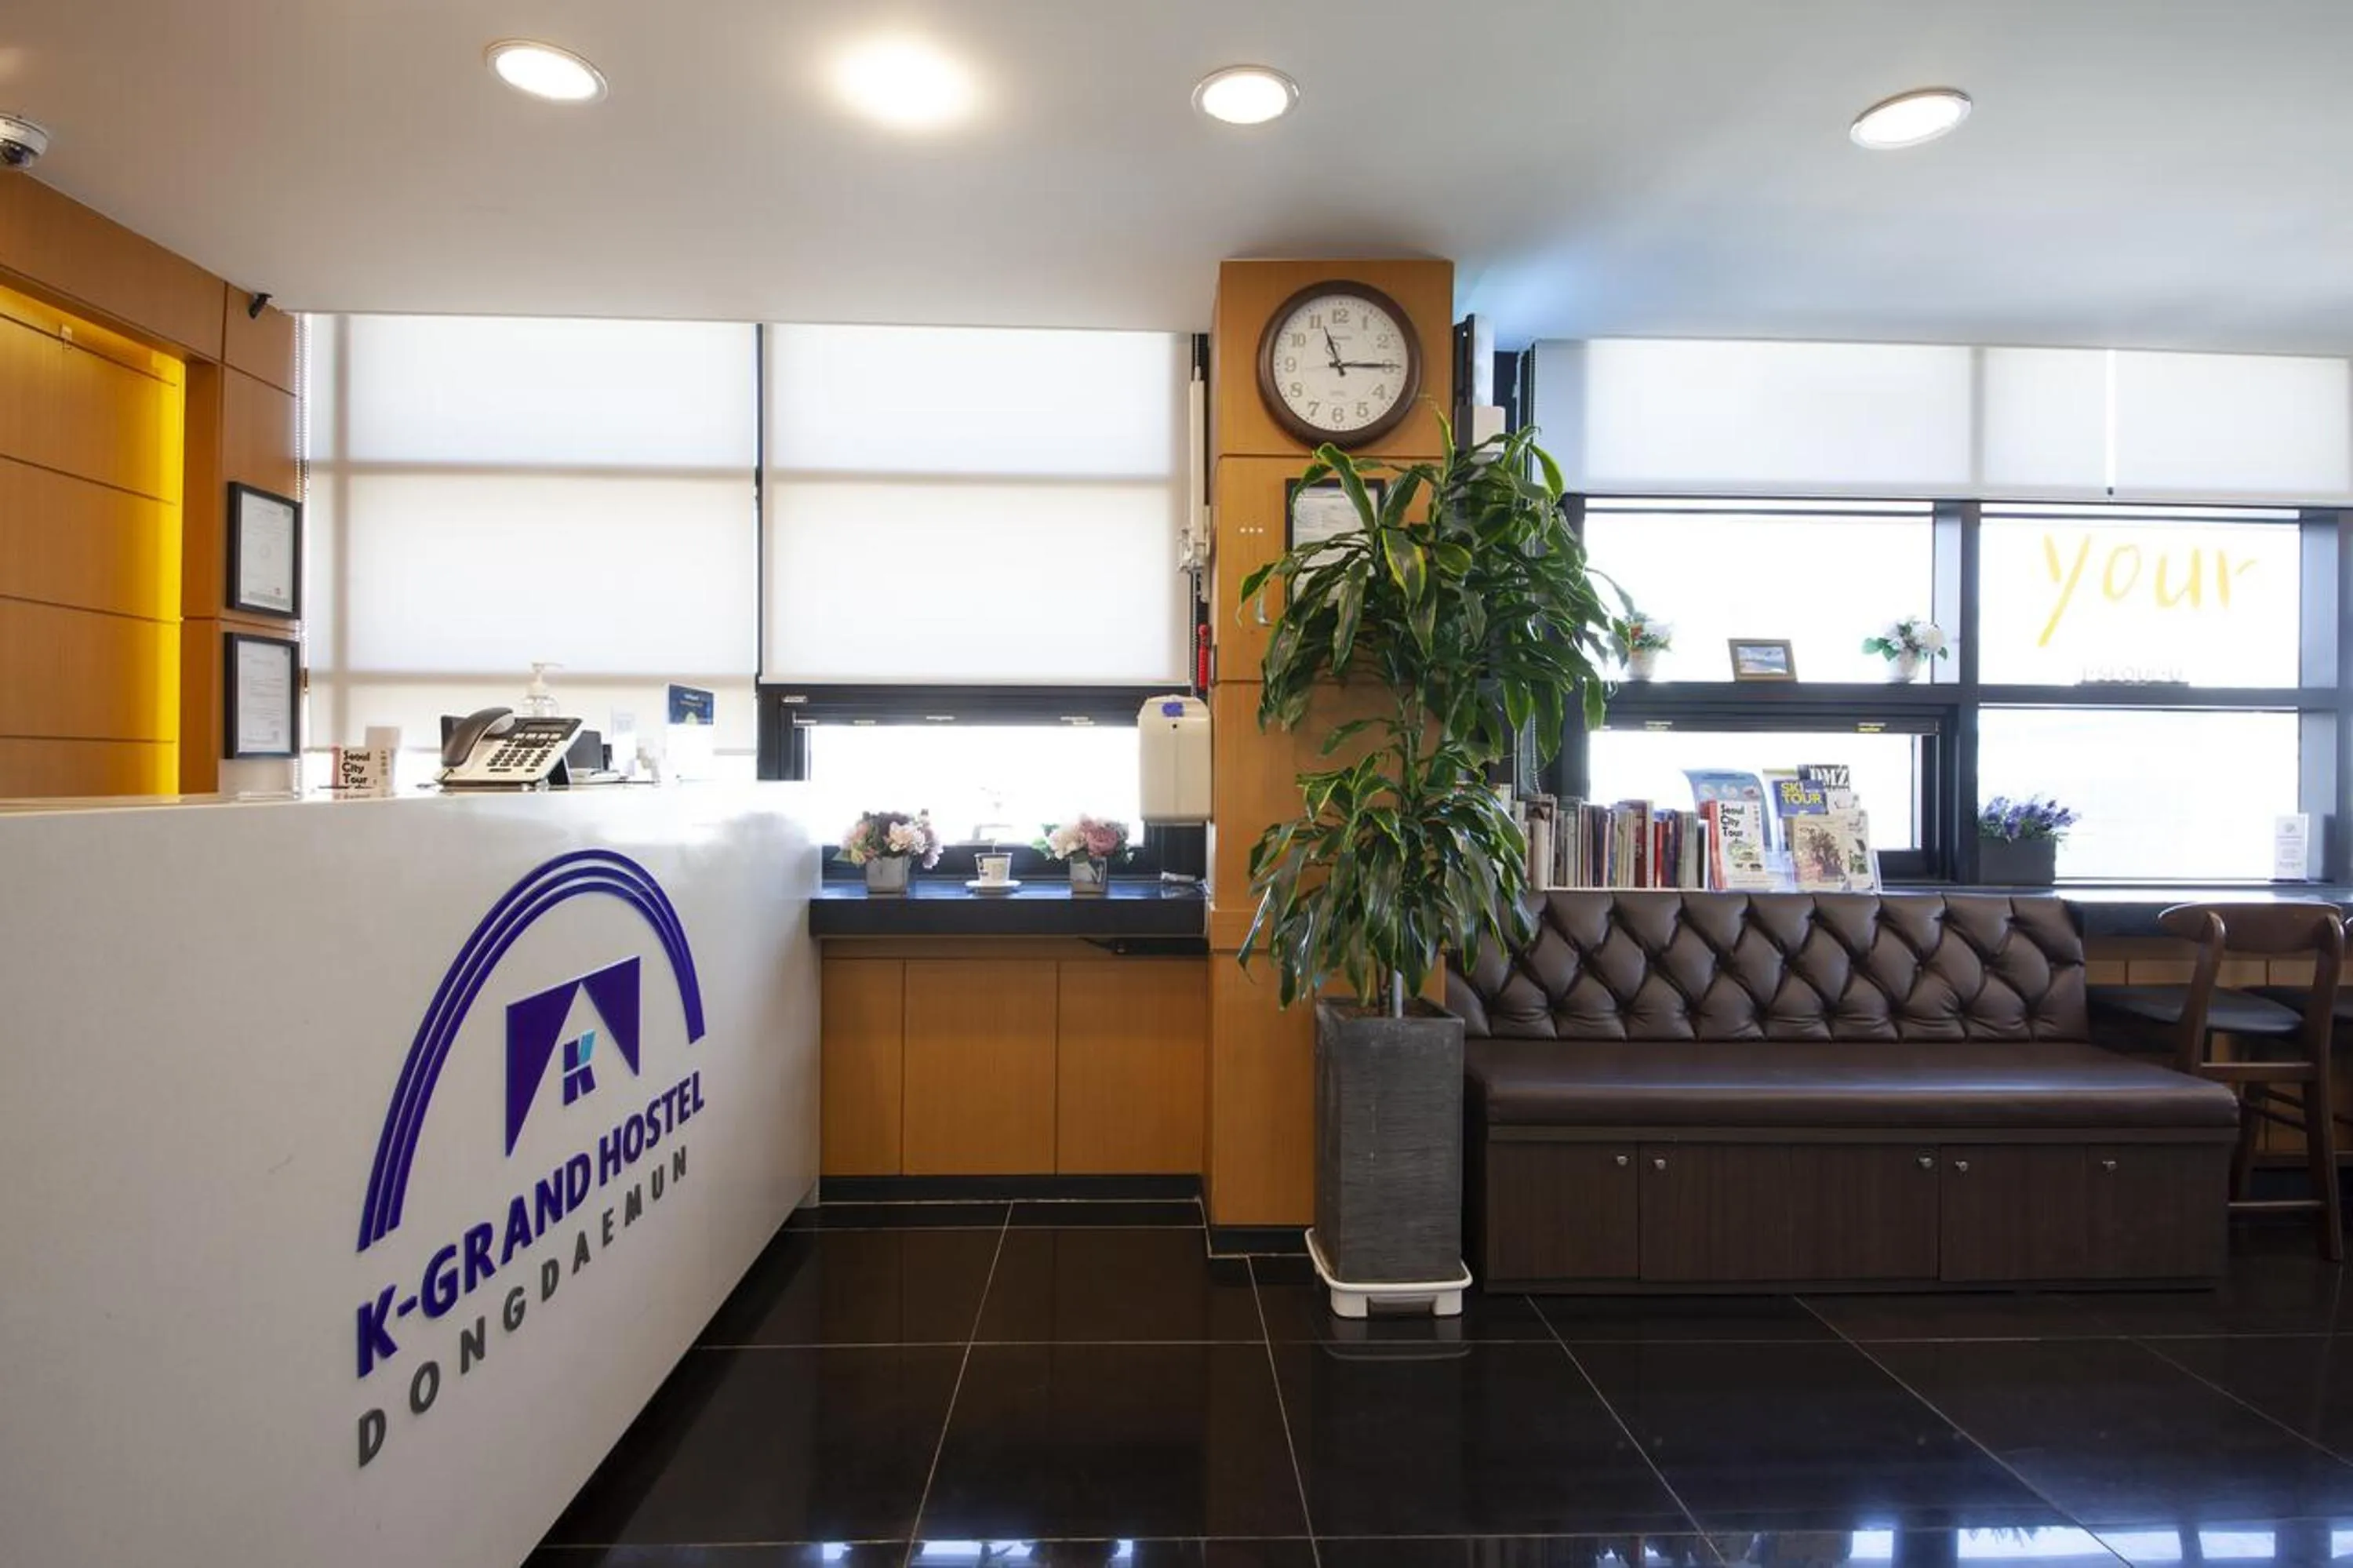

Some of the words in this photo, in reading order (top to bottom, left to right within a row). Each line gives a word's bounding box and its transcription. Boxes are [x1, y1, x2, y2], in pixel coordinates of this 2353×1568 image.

[1309, 315, 1322, 329] 11
[1332, 308, 1349, 324] 12
[1362, 315, 1369, 330] 1
[1291, 333, 1306, 347] 10
[1377, 334, 1389, 349] 2
[1284, 357, 1297, 373] 9
[1290, 383, 1303, 398] 8
[1372, 384, 1385, 399] 4
[1307, 402, 1320, 417] 7
[1332, 408, 1344, 424] 6
[1356, 402, 1369, 417] 5
[2038, 533, 2257, 647] your
[343, 750, 370, 762] Seoul
[342, 762, 365, 774] City
[343, 773, 368, 784] Tour
[1783, 791, 1822, 804] TOUR
[1721, 803, 1745, 815] Seoul
[1720, 816, 1740, 828] City
[1722, 827, 1743, 837] Tour
[356, 1151, 591, 1378] K-GRAND
[598, 1071, 704, 1187] HOSTEL
[358, 1145, 687, 1468] DONGDAEMUN
